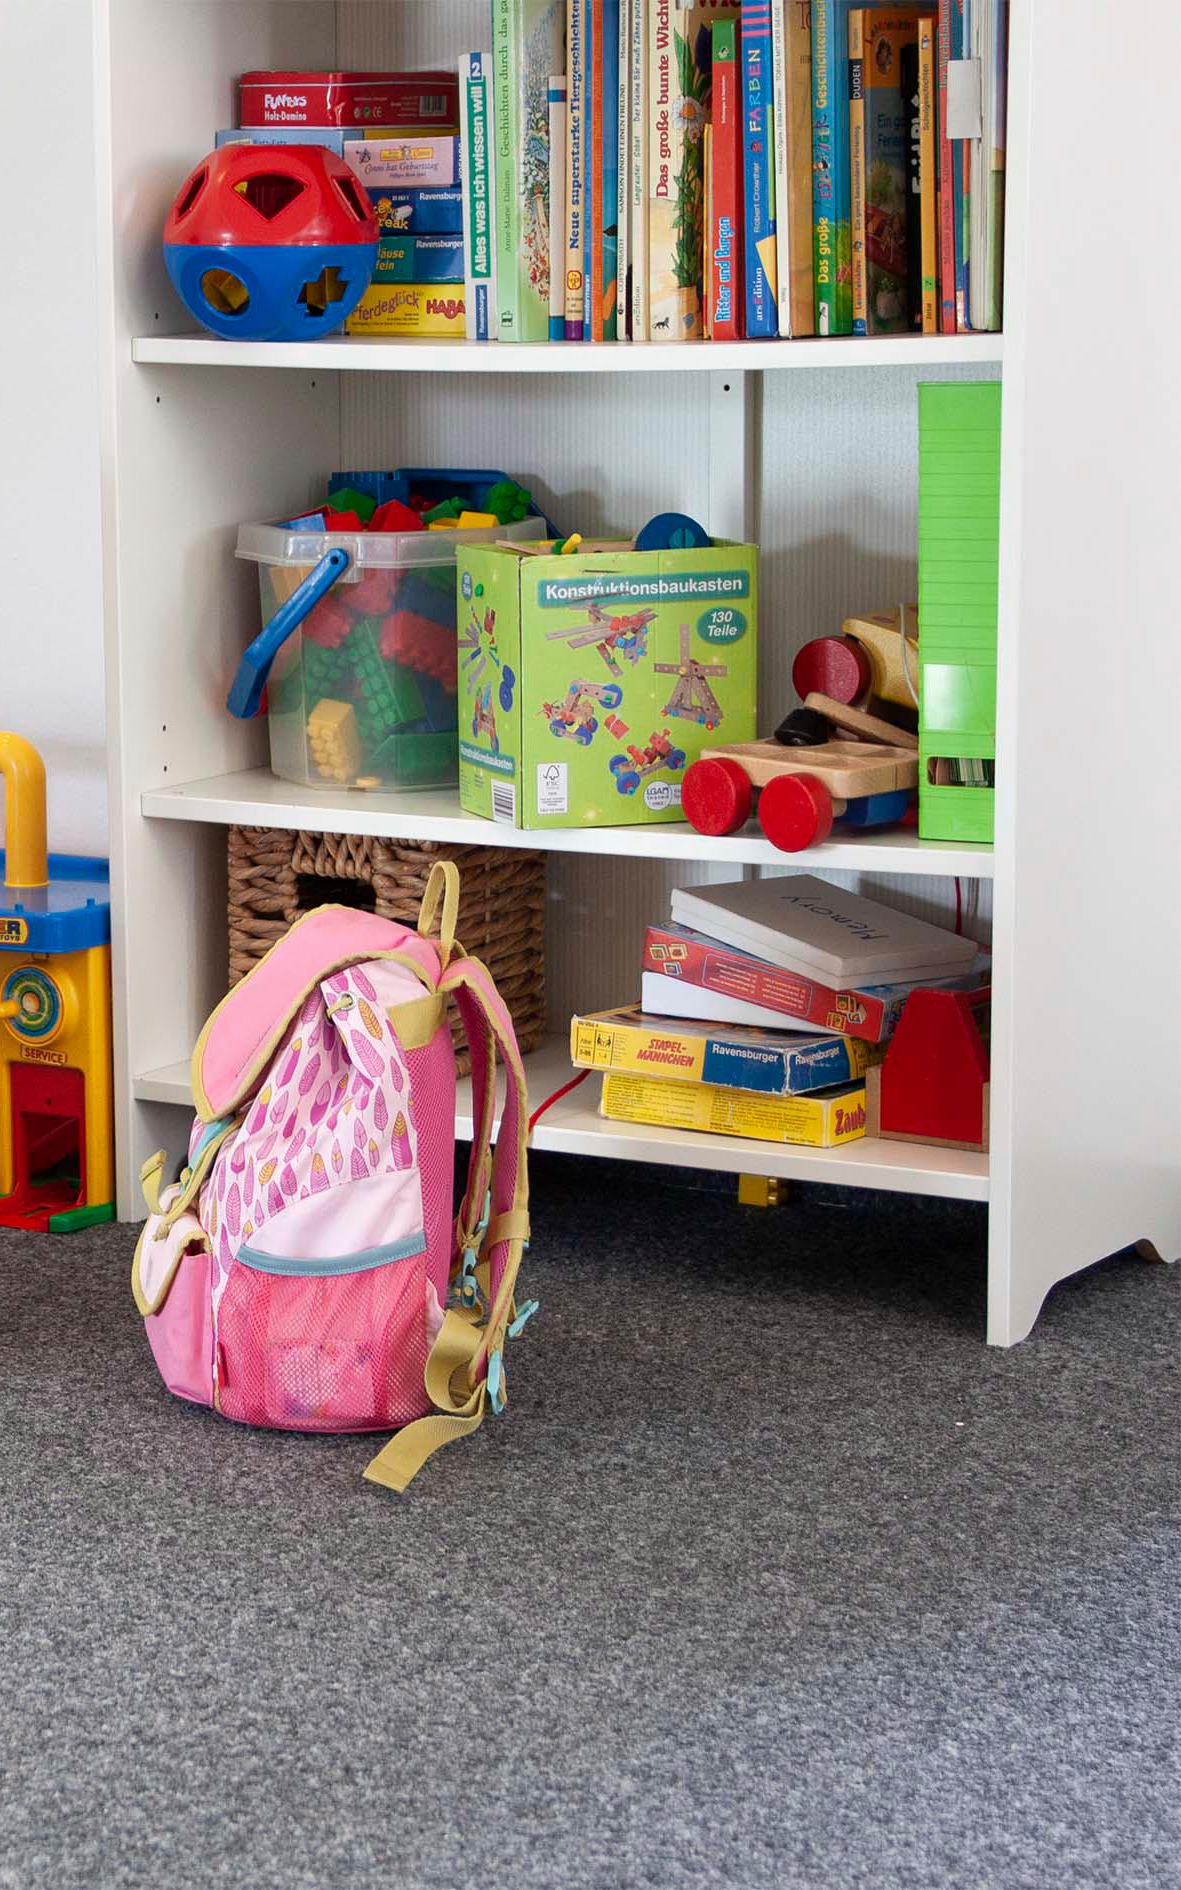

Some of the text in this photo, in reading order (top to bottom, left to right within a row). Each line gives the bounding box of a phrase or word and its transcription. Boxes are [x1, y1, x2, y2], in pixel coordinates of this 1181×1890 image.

[633, 0, 641, 19] putz
[498, 18, 508, 39] das
[471, 62, 480, 77] 2
[498, 45, 509, 81] durch
[657, 54, 669, 105] bunte
[747, 49, 761, 132] FARBEN
[852, 64, 862, 99] DUDEN
[264, 110, 307, 121] Holz-Domino
[499, 84, 510, 158] Geschichten
[656, 110, 671, 158] große
[569, 115, 582, 206] superstarke
[470, 86, 487, 273] Alles was ich wissen will
[656, 164, 668, 197] Das
[569, 211, 580, 250] Neue
[753, 203, 761, 233] Robert
[817, 216, 831, 256] große
[715, 217, 735, 323] Ritter und Burgen
[818, 260, 829, 284] Das
[426, 298, 466, 319] HABA
[752, 267, 763, 321] arsEdition
[546, 577, 742, 600] Konstruktionsbaukasten
[707, 624, 738, 637] Teile
[711, 611, 733, 623] 130
[24, 1047, 65, 1064] SERVICE
[636, 1049, 695, 1067] MÄNNCHEN
[648, 1038, 687, 1053] STAPEL-
[712, 1043, 779, 1063] Ravensburger
[795, 1046, 840, 1065] Ravensburger
[834, 1103, 866, 1136] Zaub
